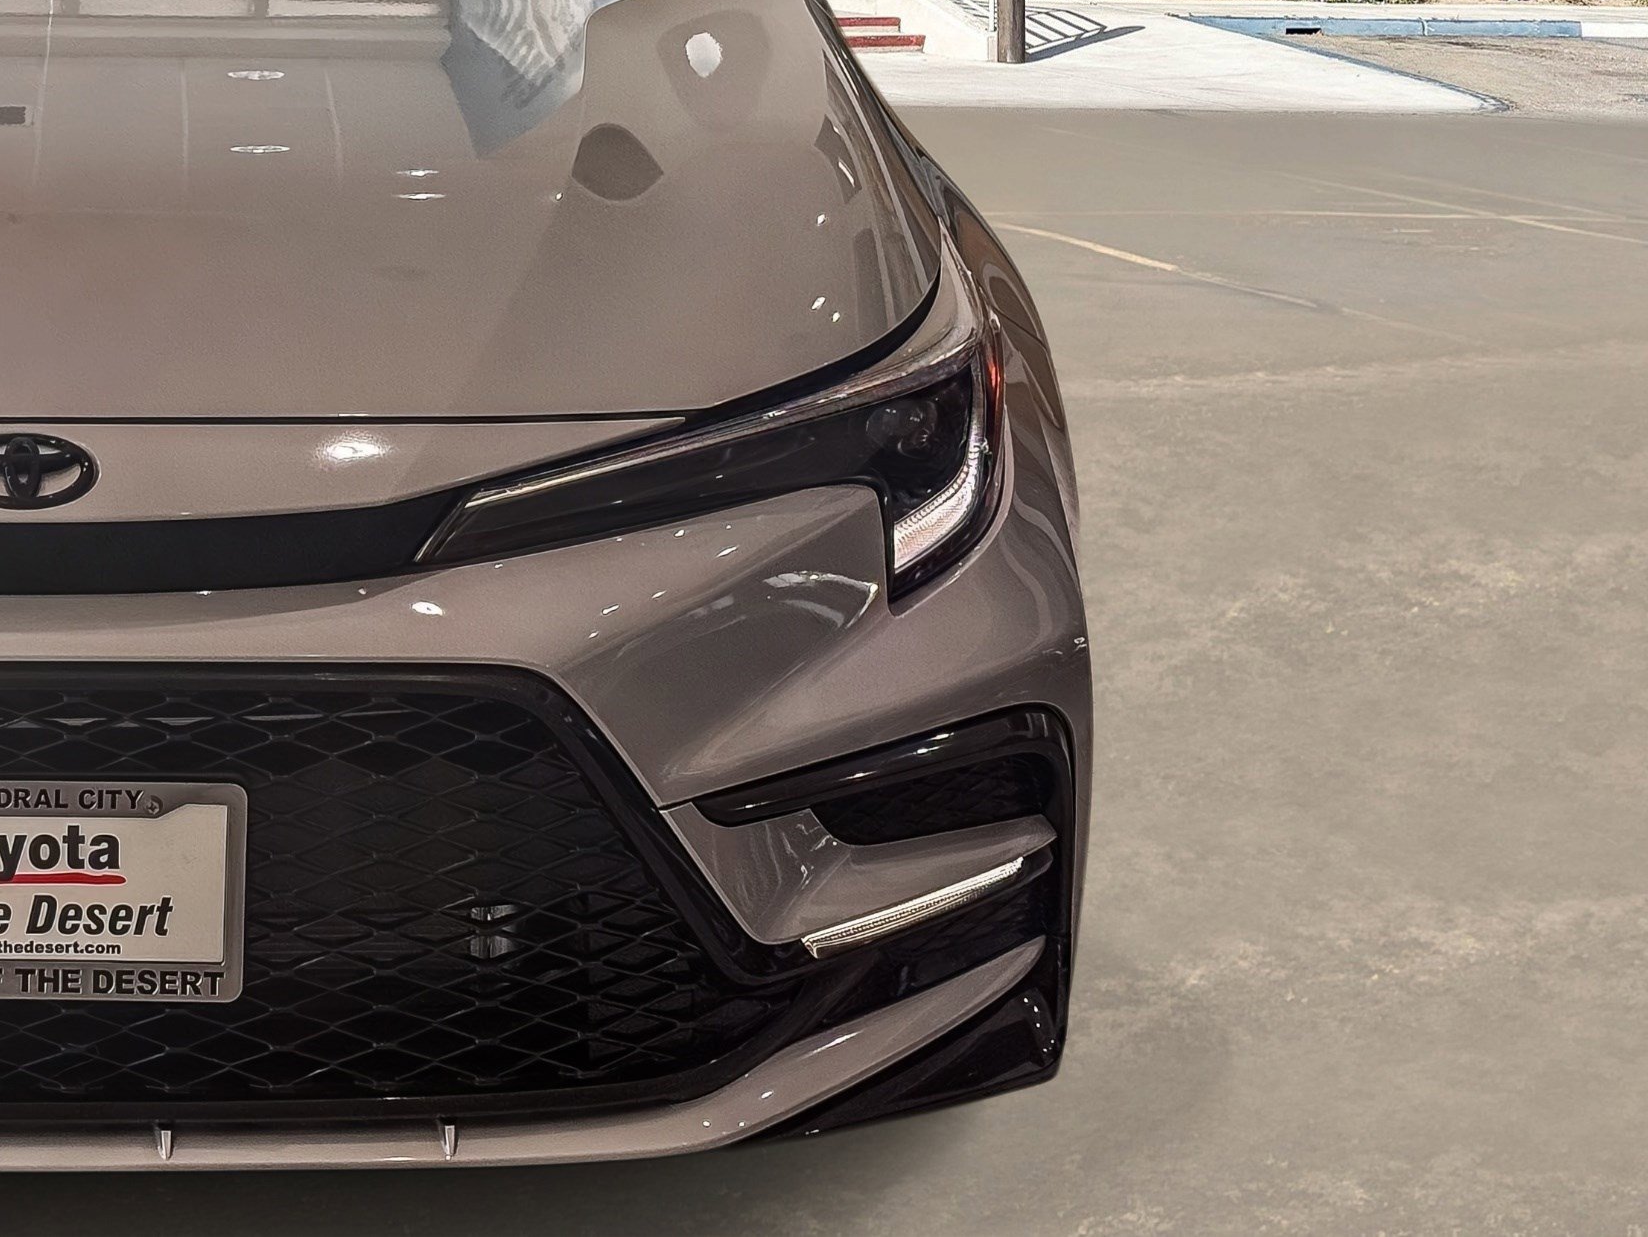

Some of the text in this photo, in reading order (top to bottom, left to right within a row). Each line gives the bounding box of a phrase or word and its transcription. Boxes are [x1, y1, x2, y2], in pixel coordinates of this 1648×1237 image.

[78, 789, 143, 810] CITY
[25, 896, 174, 936] Desert
[16, 969, 82, 994] THE
[92, 970, 225, 996] DESERT
